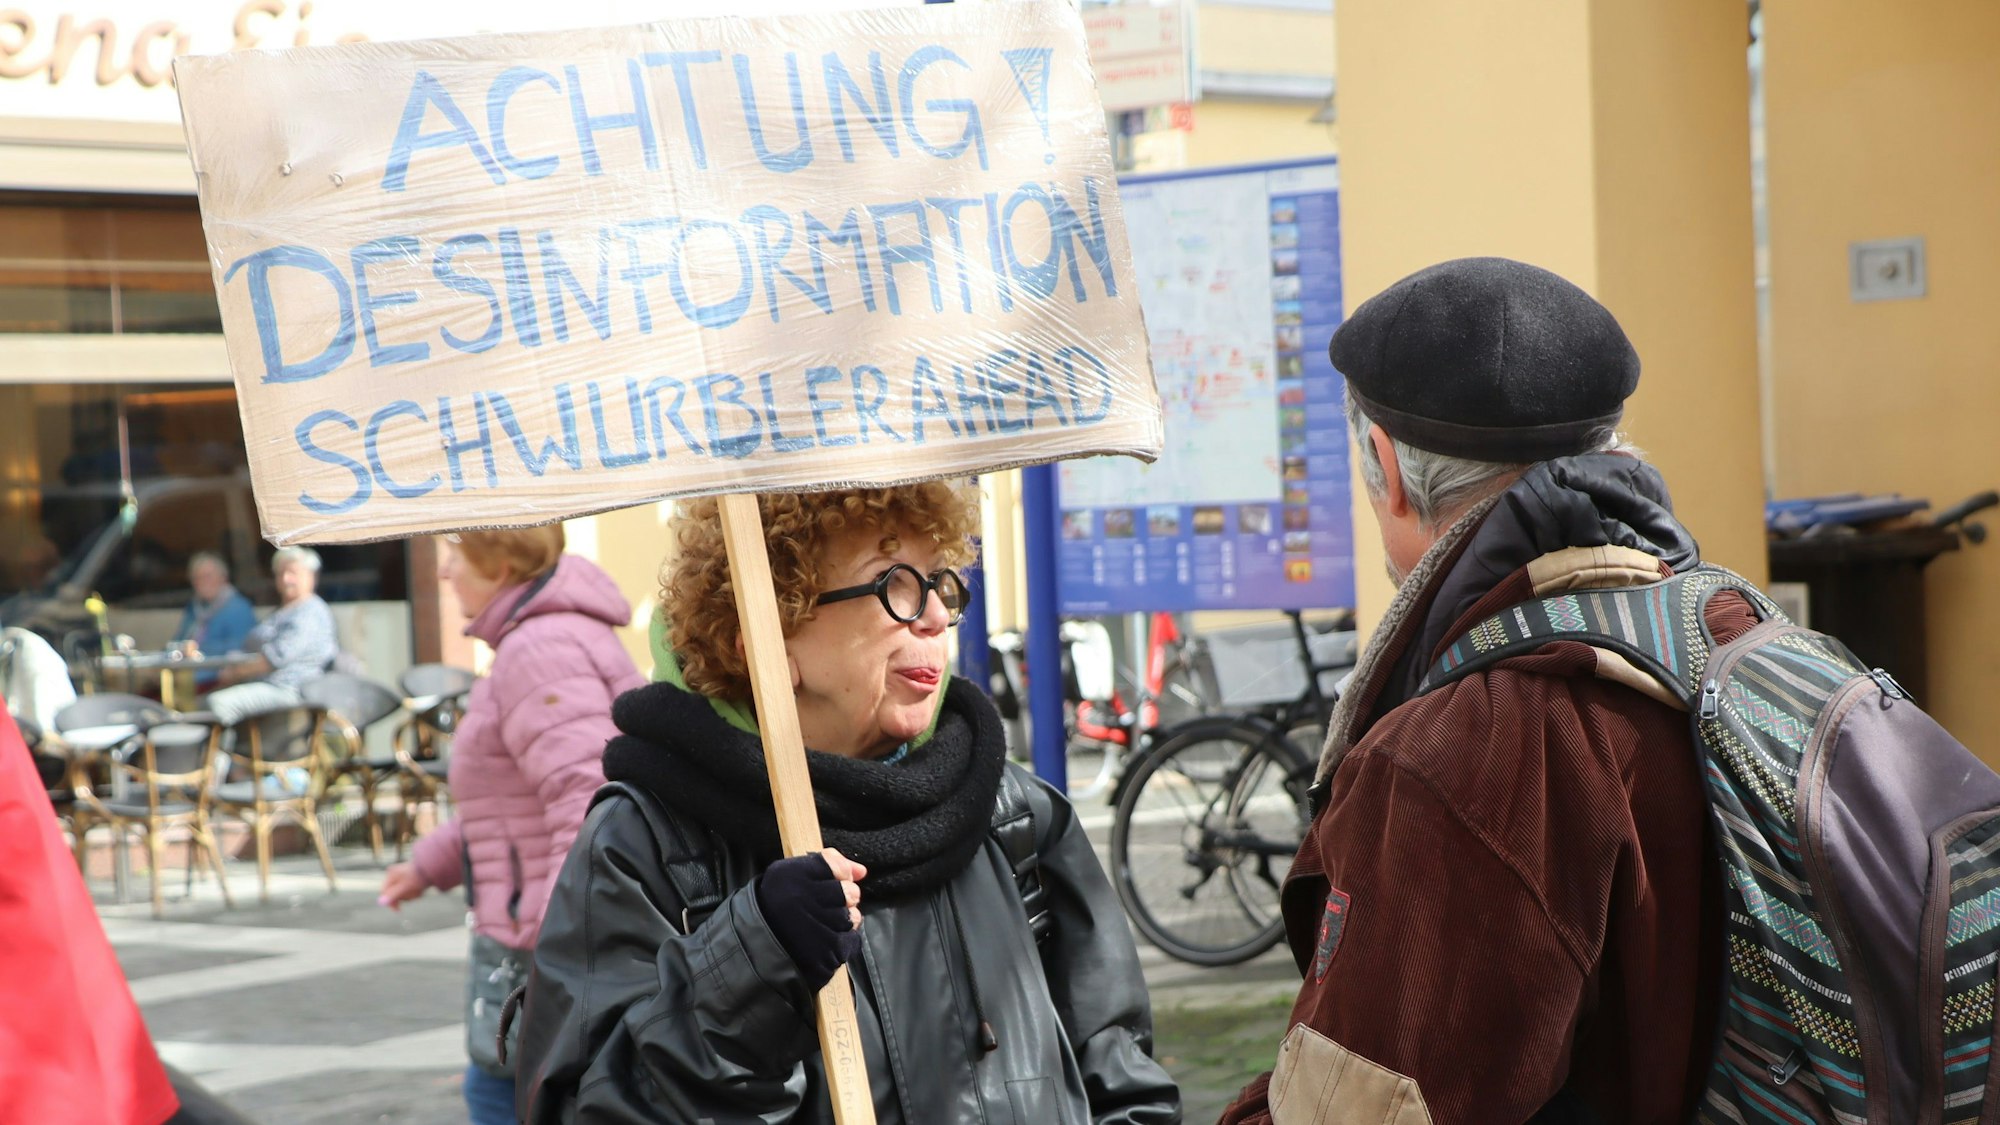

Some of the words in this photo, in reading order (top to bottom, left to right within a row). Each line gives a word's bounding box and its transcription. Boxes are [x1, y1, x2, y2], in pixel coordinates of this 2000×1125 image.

[224, 178, 1117, 384] DESINFORMATION
[295, 363, 908, 514] SCHWURBLER
[911, 346, 1112, 444] AHEAD
